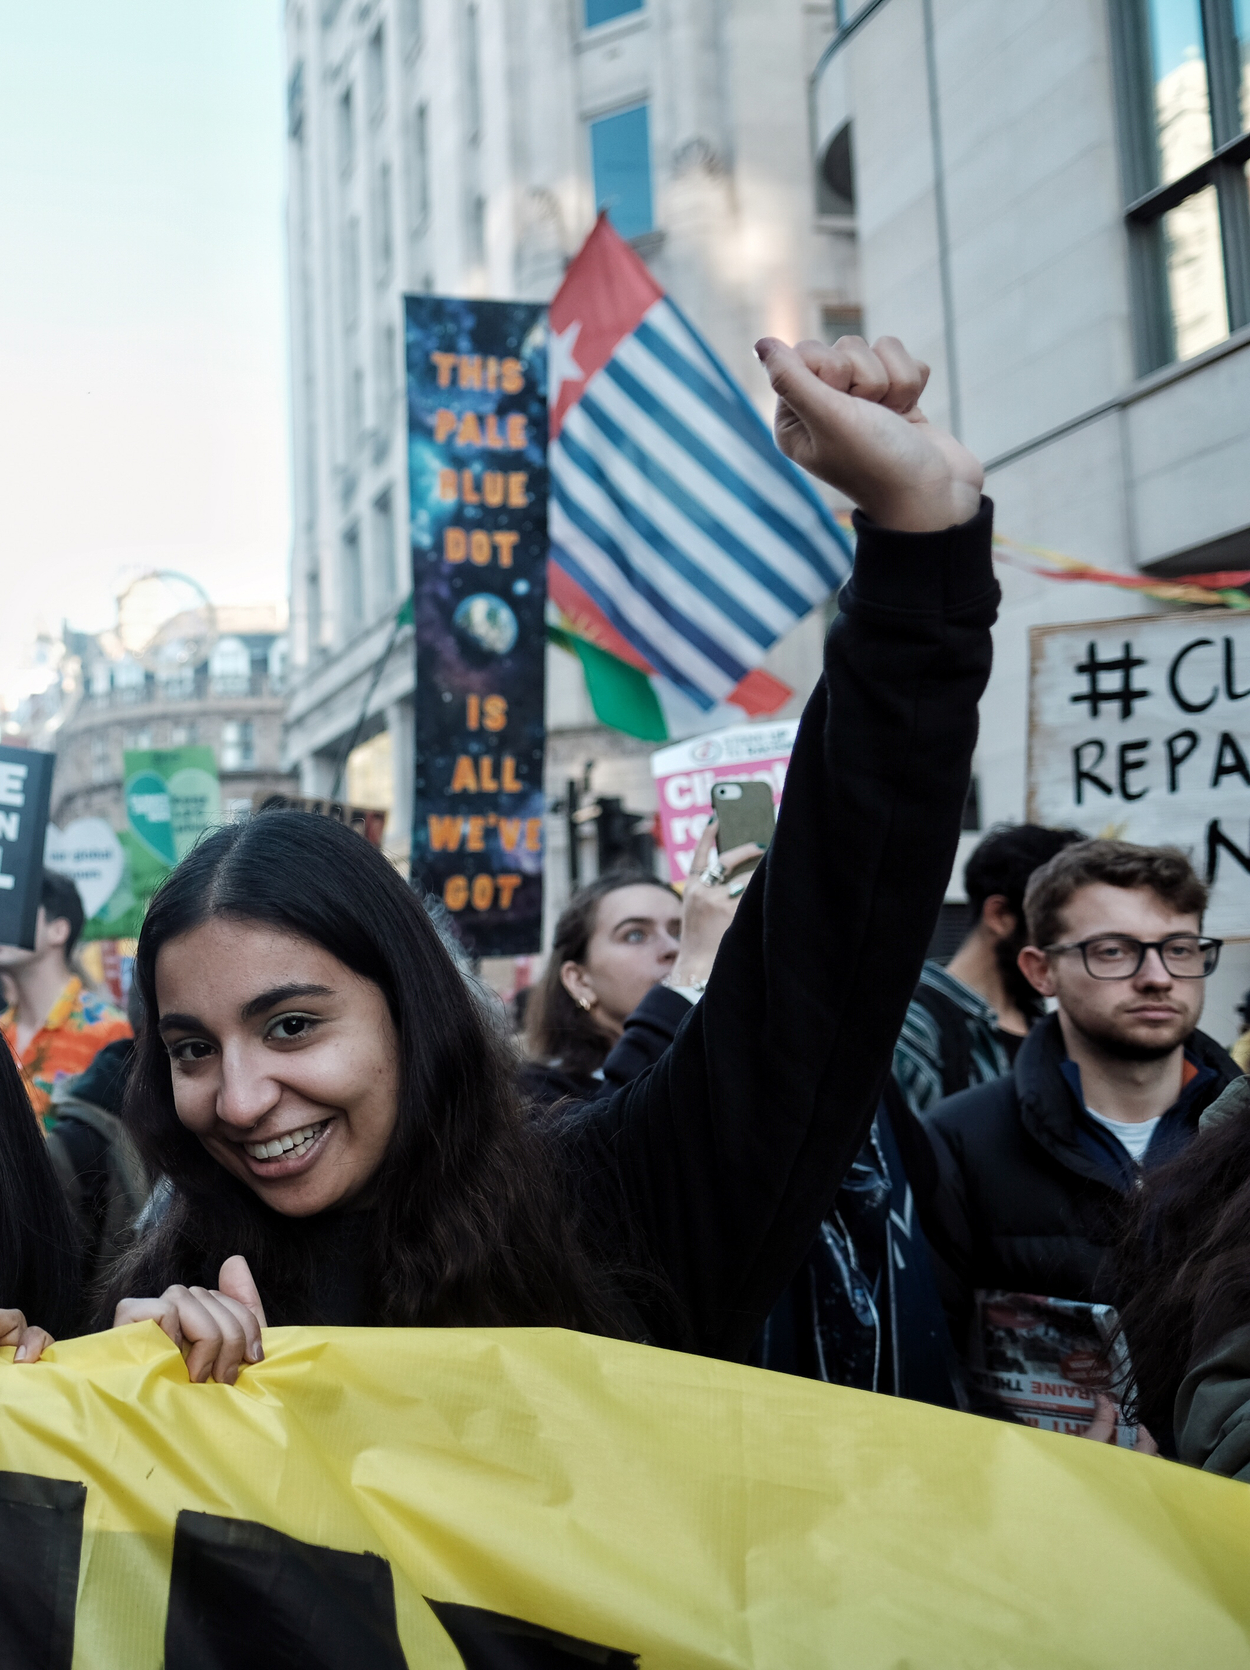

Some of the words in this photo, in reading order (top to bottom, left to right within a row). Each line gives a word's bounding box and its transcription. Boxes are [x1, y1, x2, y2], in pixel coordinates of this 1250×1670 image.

[430, 351, 525, 395] THIS
[434, 408, 528, 449] PALE
[439, 468, 529, 509] BLUE
[444, 526, 521, 568] DOT
[466, 693, 508, 732] IS
[452, 755, 523, 793] ALL
[428, 813, 542, 852] WE'VE
[444, 873, 523, 912] GOT
